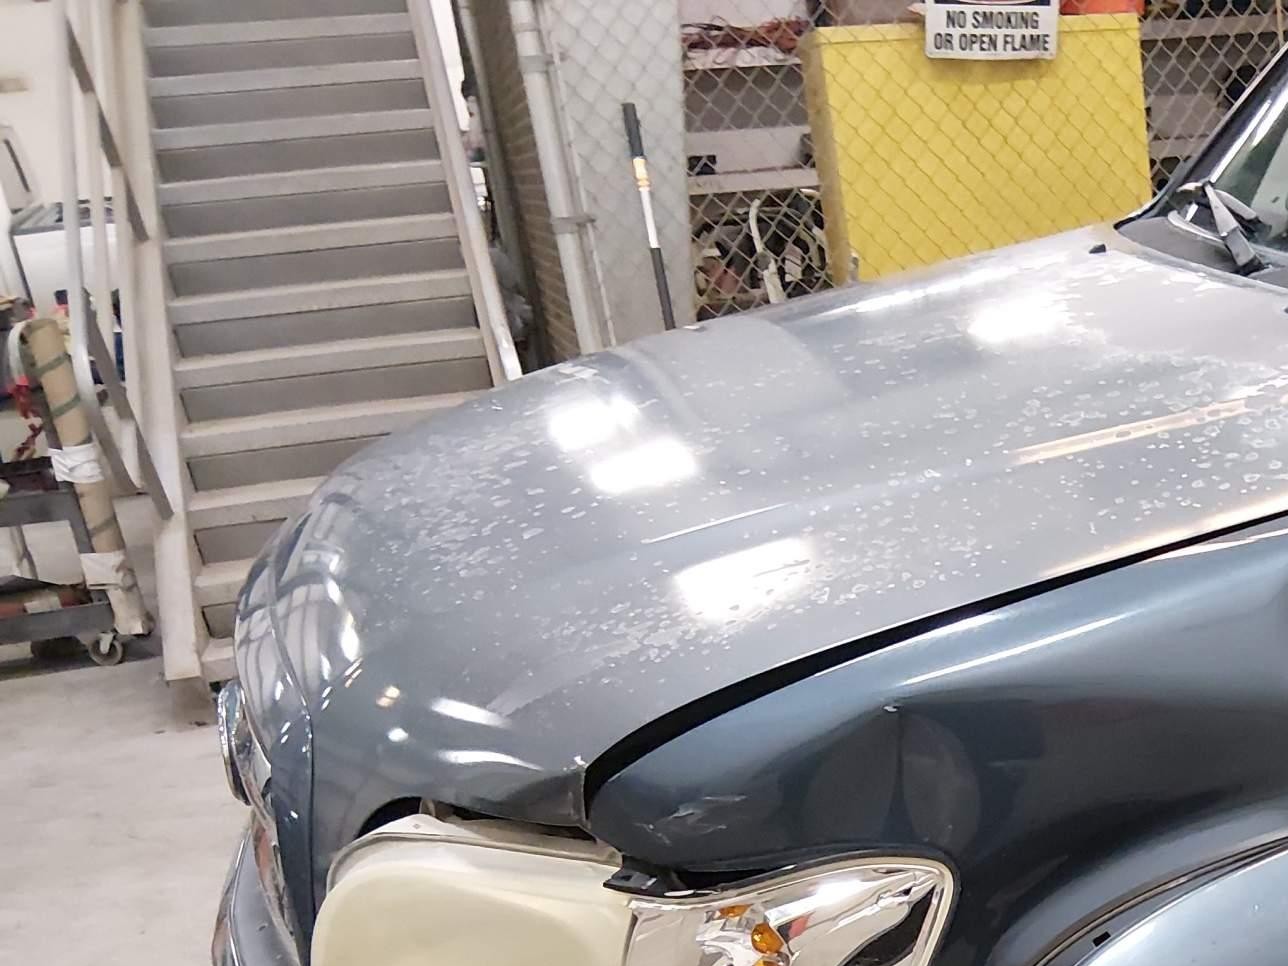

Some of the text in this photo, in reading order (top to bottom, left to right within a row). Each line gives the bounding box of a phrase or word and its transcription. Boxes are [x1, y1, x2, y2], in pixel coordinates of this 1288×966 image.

[945, 10, 1040, 30] NO SMOKING
[933, 32, 1051, 52] OR OPEN FLAME
